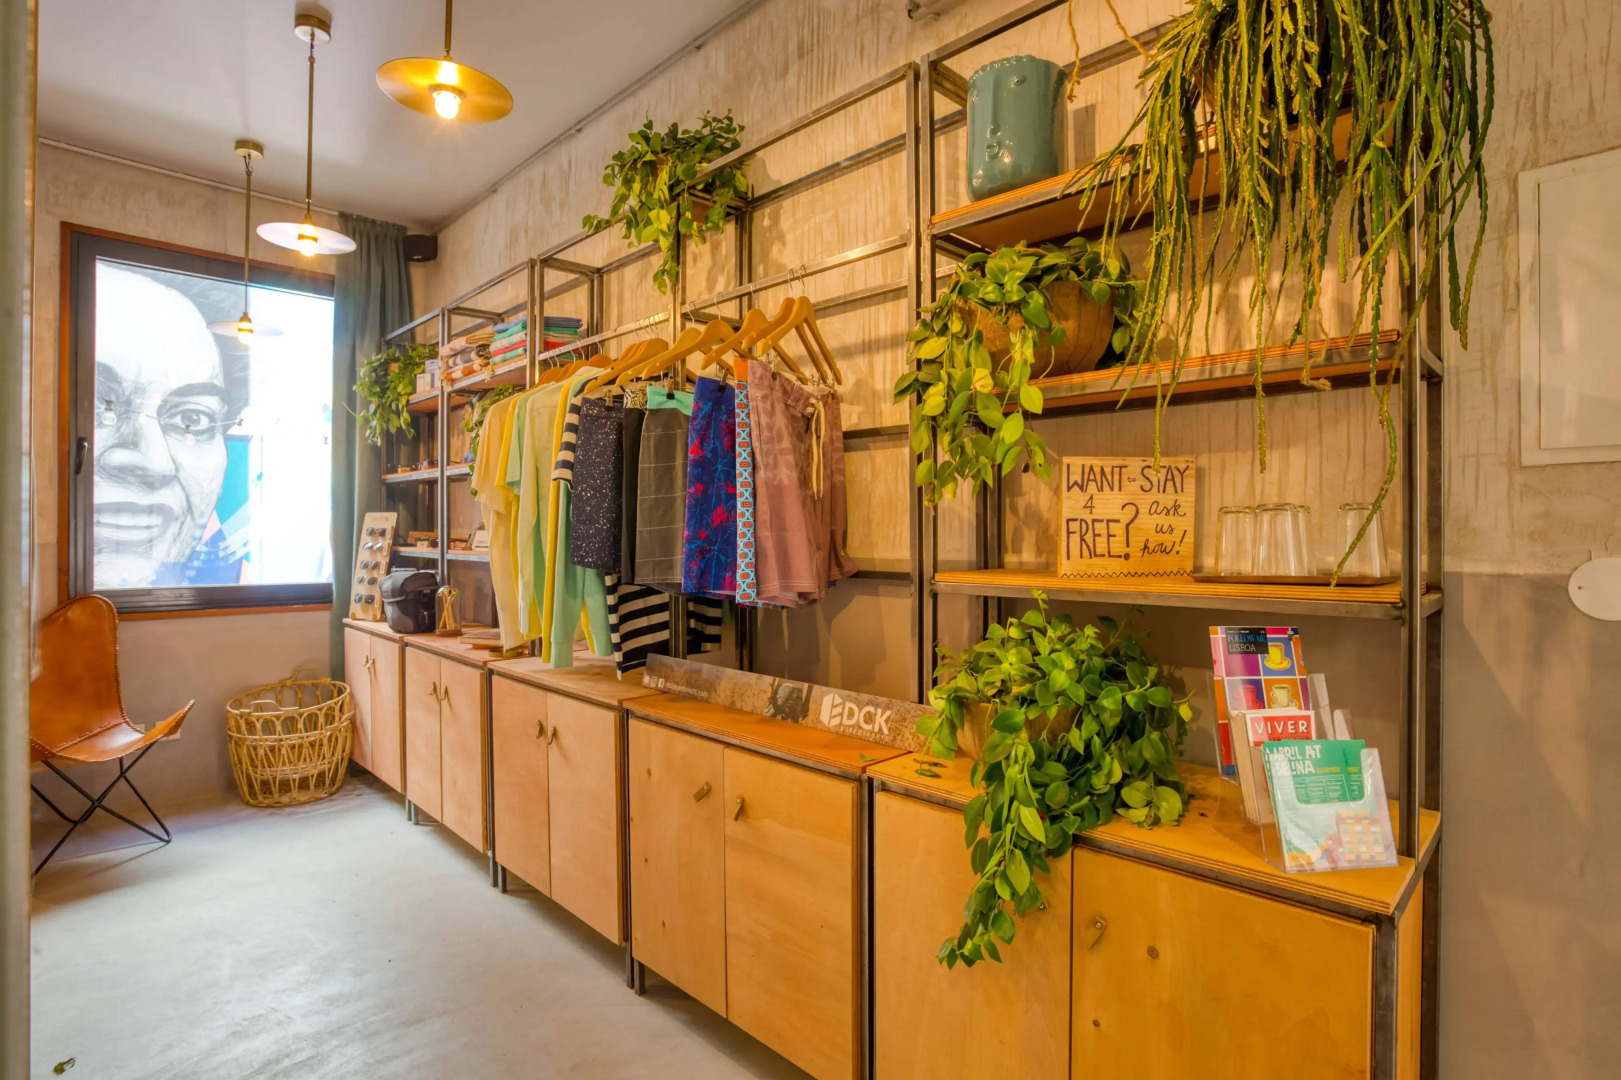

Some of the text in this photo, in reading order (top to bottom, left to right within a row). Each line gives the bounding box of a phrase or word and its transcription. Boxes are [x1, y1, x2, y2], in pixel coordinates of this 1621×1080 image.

[1066, 463, 1128, 493] WANT
[1140, 464, 1190, 494] STAY
[1082, 494, 1096, 514] 4
[1149, 498, 1187, 517] ask
[1066, 502, 1140, 561] FREE?
[1155, 523, 1175, 535] us
[1140, 529, 1187, 557] how!
[1227, 634, 1255, 643] FOLLOW
[1228, 643, 1257, 652] LISBOA
[1254, 720, 1308, 735] VIVER
[1305, 744, 1321, 760] AT
